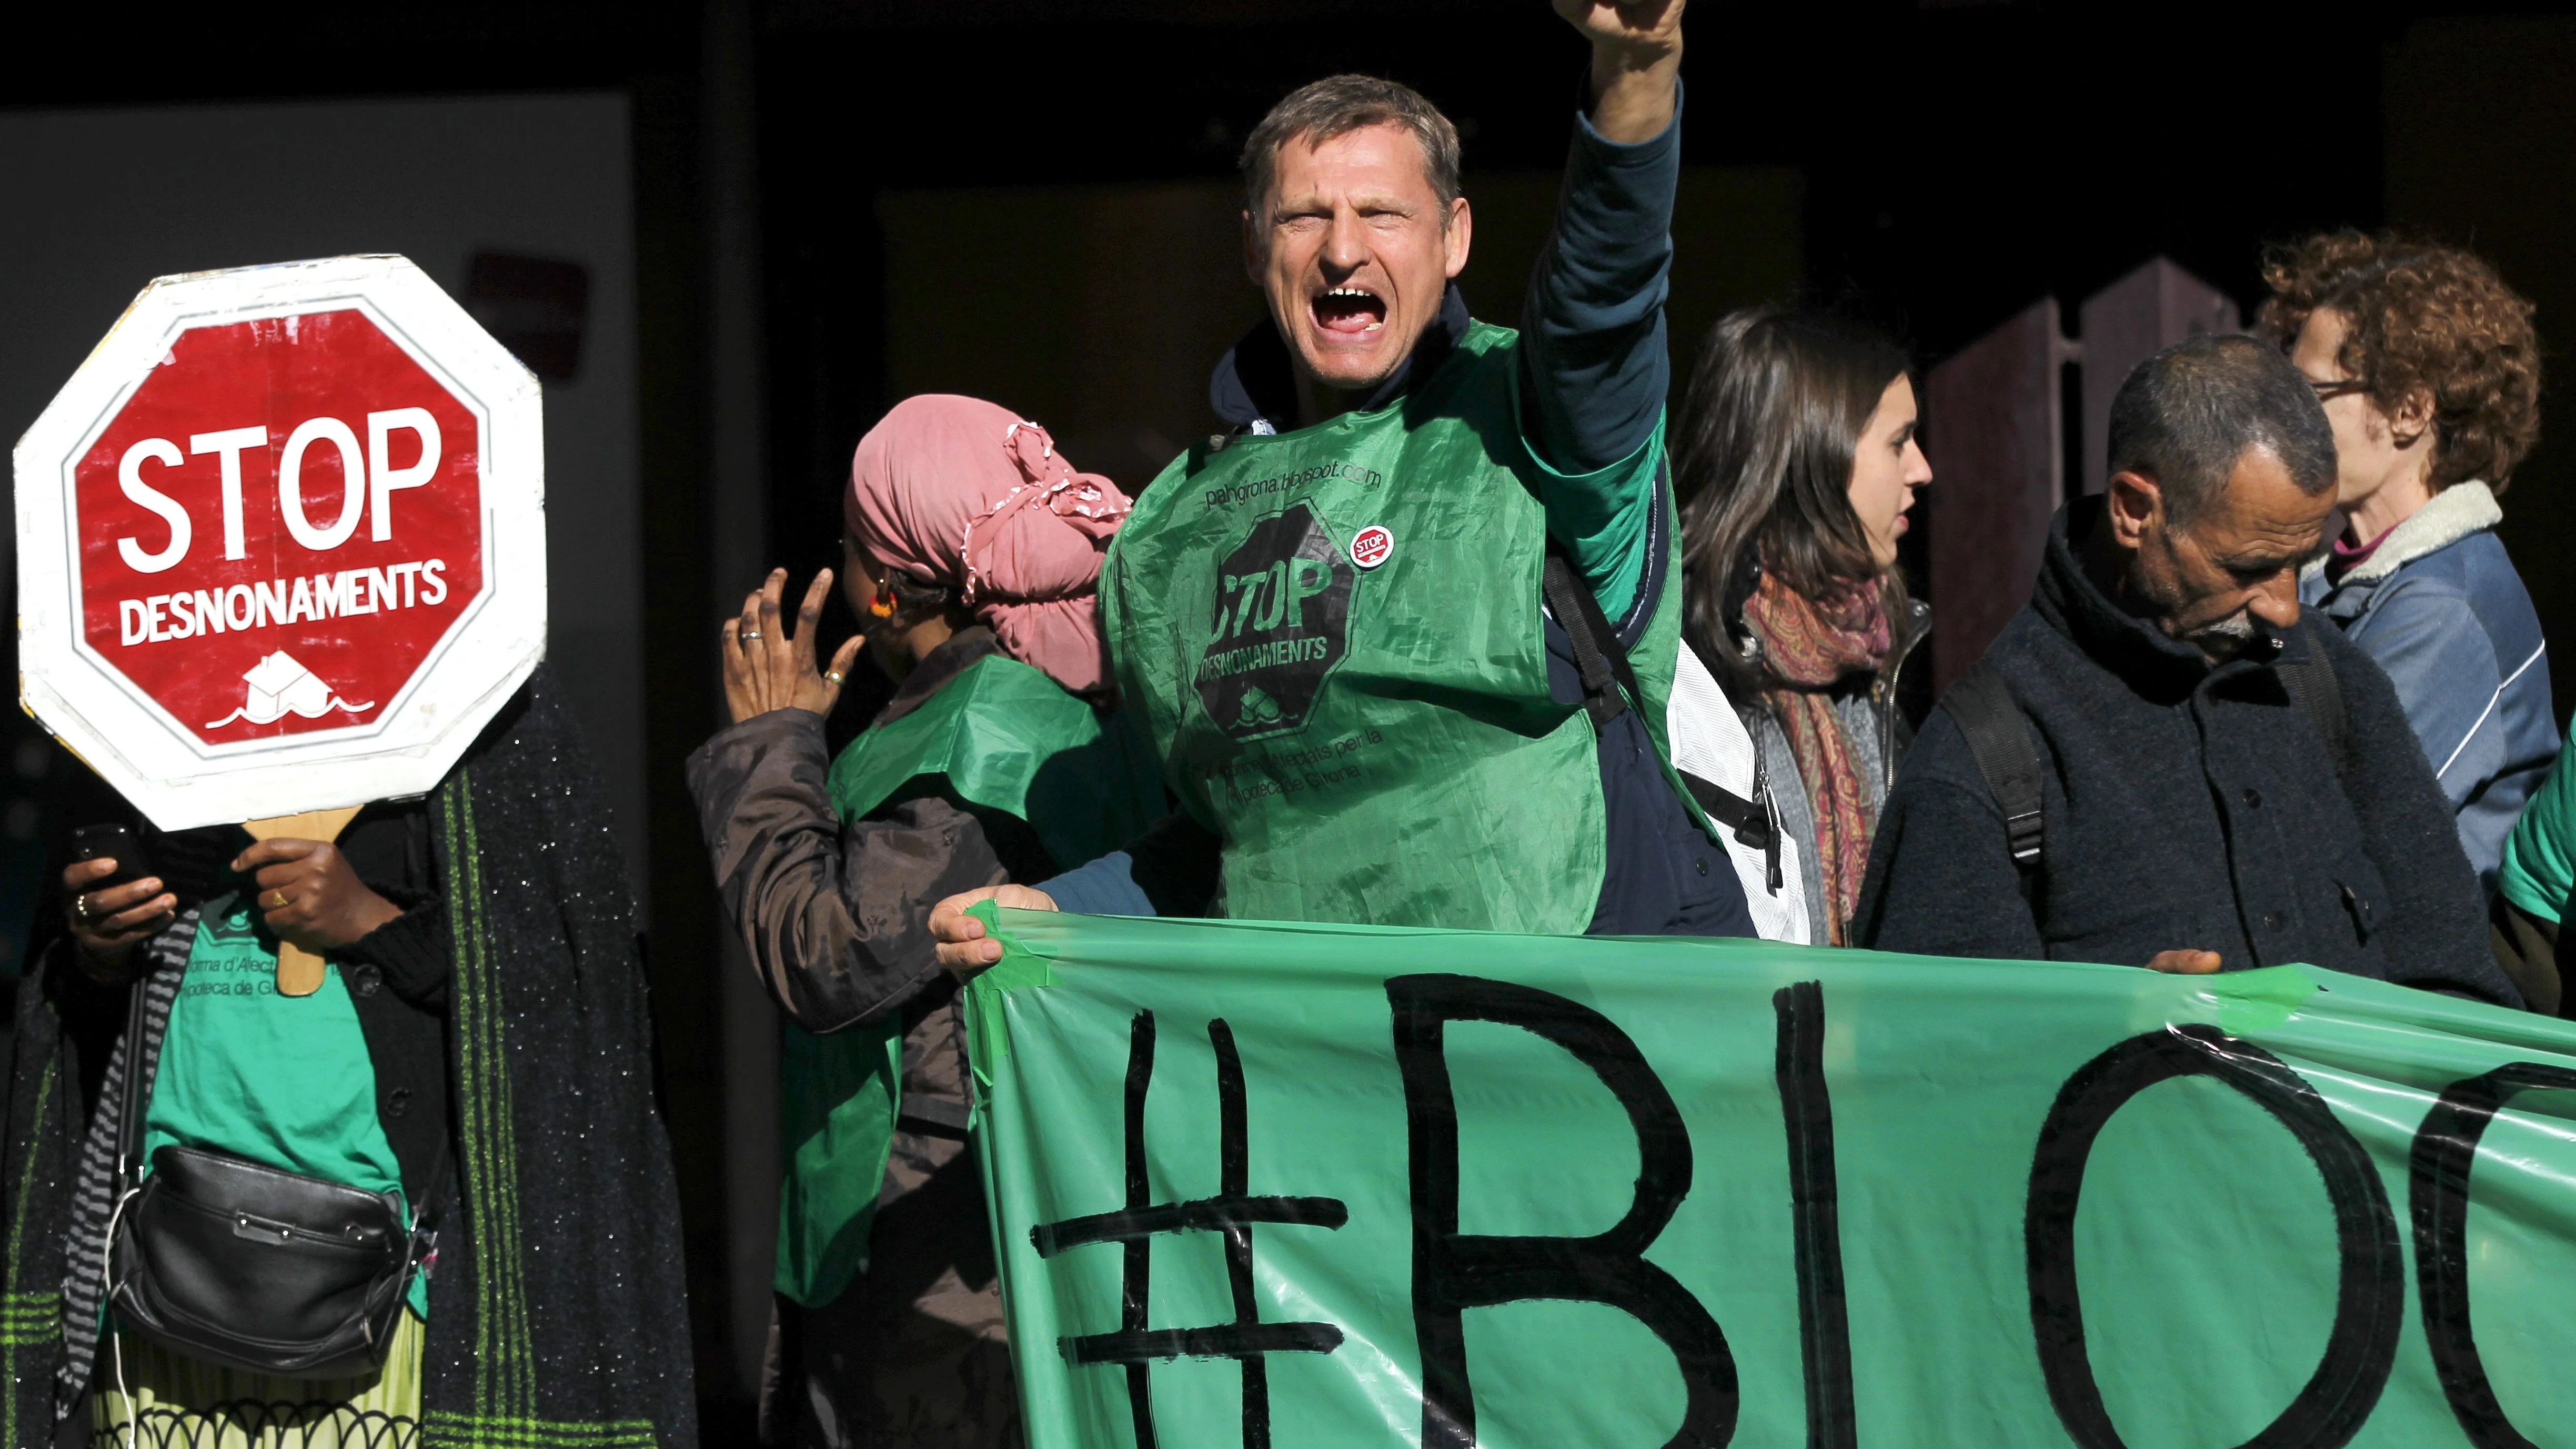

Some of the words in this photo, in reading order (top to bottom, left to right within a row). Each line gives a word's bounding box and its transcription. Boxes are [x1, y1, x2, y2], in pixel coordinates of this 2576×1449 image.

[117, 406, 442, 574] STOP
[1205, 460, 1382, 510] pahgirona.blogspot.com
[1356, 534, 1384, 554] STOP
[119, 558, 447, 647] DESNONAMENTS
[1201, 636, 1327, 682] DESNONAMENTS
[1335, 734, 1362, 759] per
[1365, 728, 1384, 746] la
[1305, 764, 1362, 789] Girona
[234, 980, 254, 996] de
